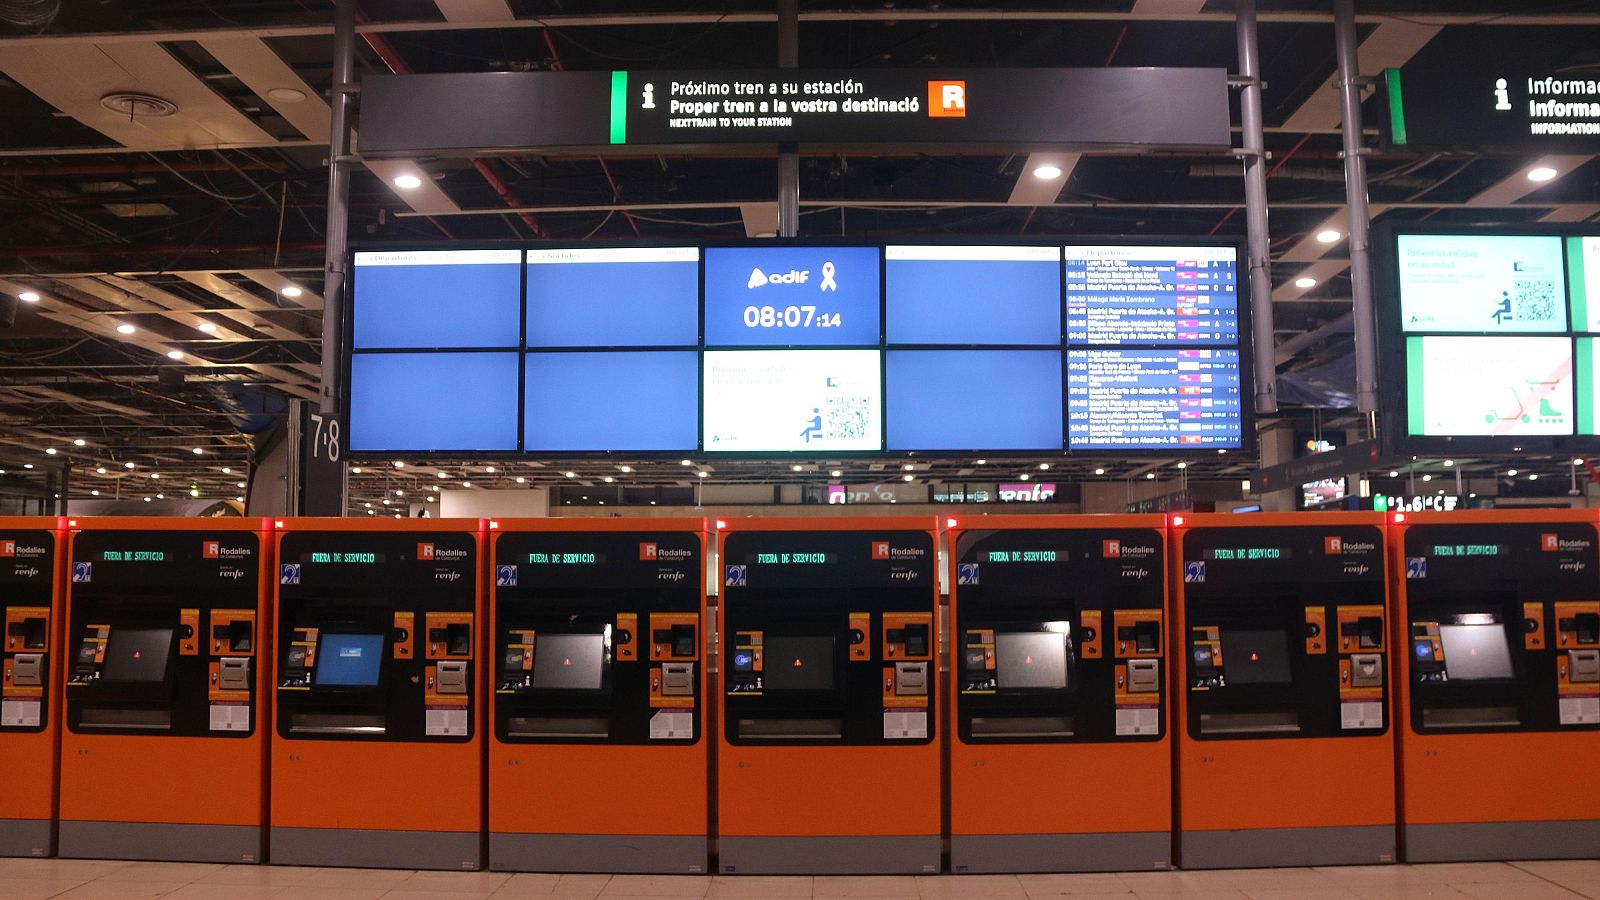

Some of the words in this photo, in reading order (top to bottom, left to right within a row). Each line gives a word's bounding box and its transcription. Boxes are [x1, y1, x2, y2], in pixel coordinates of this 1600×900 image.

[671, 81, 730, 97] Próximo
[734, 82, 764, 95] tren
[768, 85, 777, 95] a
[781, 85, 799, 95] su
[803, 79, 864, 95] estación
[670, 99, 720, 117] Proper
[723, 99, 754, 114] tren
[759, 101, 769, 113] a
[773, 98, 787, 113] la
[790, 100, 838, 113] vostra
[842, 96, 920, 113] destinació
[719, 118, 731, 127] TO
[732, 118, 756, 127] YOUR
[757, 117, 792, 127] STATION
[769, 270, 810, 284] adif
[1331, 539, 1341, 550] R
[1548, 536, 1557, 547] R
[6, 543, 14, 554] R
[16, 546, 46, 554] Rodalies
[210, 544, 218, 554] R
[424, 545, 434, 556] R
[646, 545, 656, 556] R
[878, 544, 889, 555] R
[1110, 542, 1120, 554] R
[1122, 546, 1154, 554] Rodalies
[104, 551, 122, 560] FUERA
[124, 551, 133, 560] DE
[134, 551, 164, 560] SERVICIO
[312, 553, 330, 562] FUERA
[334, 553, 342, 562] DE
[344, 553, 374, 562] SERVICIO
[529, 554, 548, 564] FUERA
[552, 554, 560, 564] DE
[563, 554, 594, 564] SERVICIO
[758, 554, 778, 564] FUERA
[782, 554, 790, 564] DE
[792, 554, 825, 564] SERVICIO
[989, 552, 1009, 562] FUERA
[1012, 552, 1020, 562] DE
[1024, 552, 1056, 562] SERVICIO
[1214, 549, 1234, 559] FUERA
[1238, 549, 1246, 559] DE
[1248, 549, 1280, 559] SERVICIO
[14, 567, 38, 578] renfe
[220, 569, 244, 579] renfe
[891, 568, 918, 581] renfe
[1122, 567, 1148, 579] renfe
[1344, 563, 1368, 575] renfe
[435, 570, 461, 582] renfe
[658, 570, 685, 582] renfe
